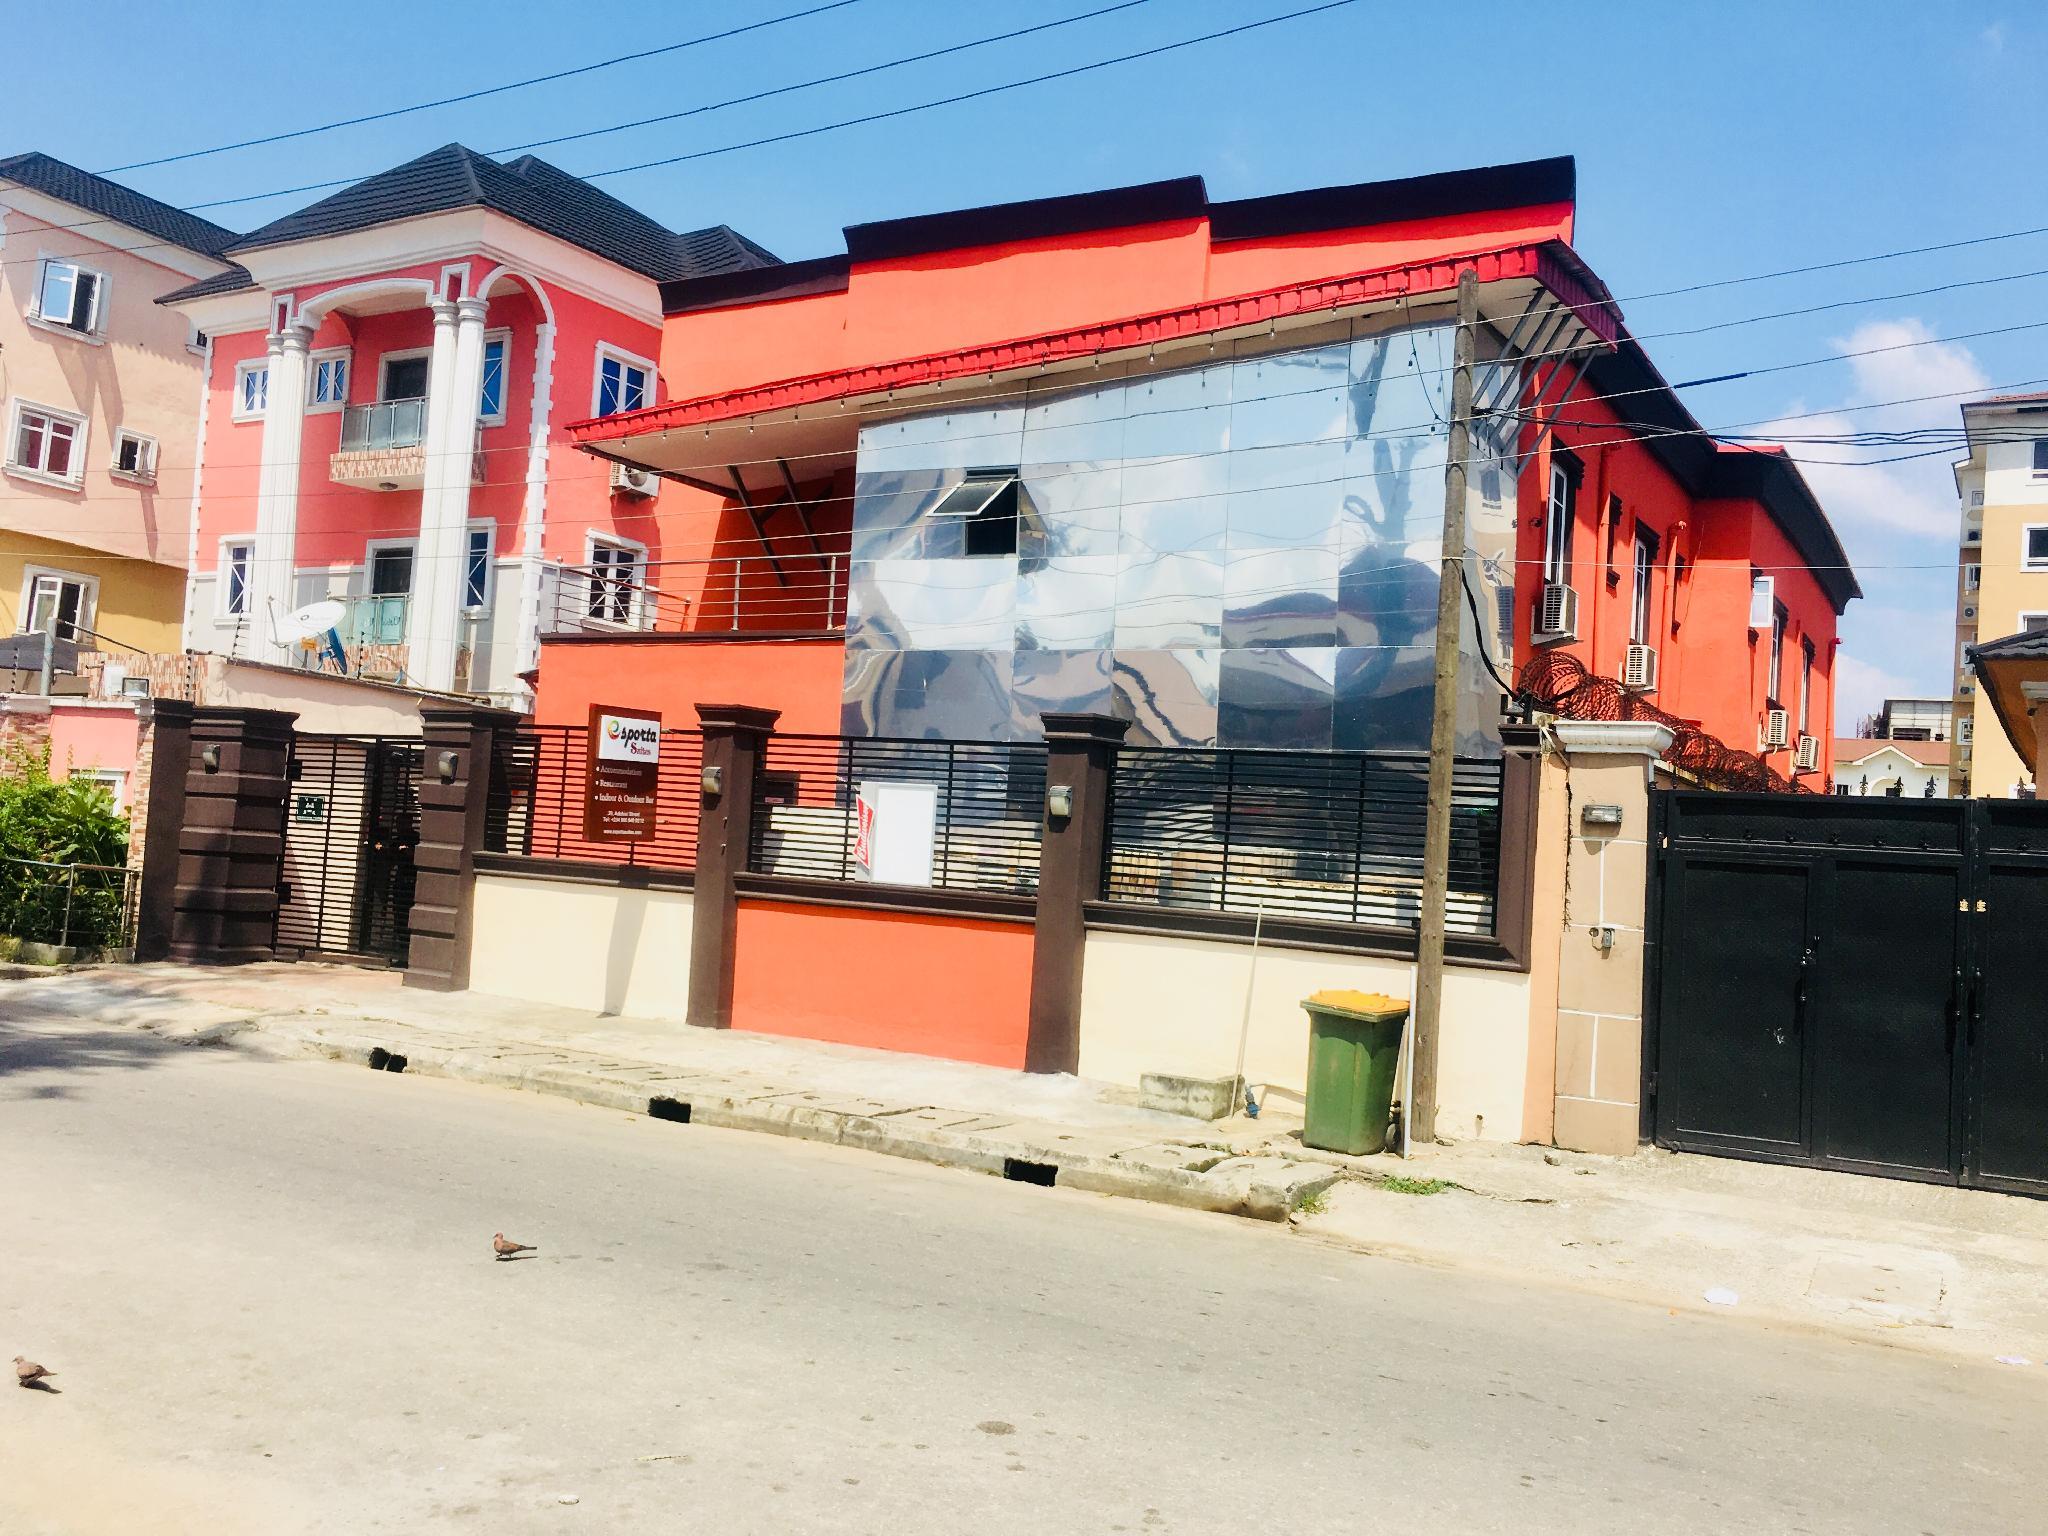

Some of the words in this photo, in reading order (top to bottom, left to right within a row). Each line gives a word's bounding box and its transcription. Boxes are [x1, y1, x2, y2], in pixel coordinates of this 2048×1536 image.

[630, 742, 651, 755] Suites
[599, 779, 628, 789] Restaurant
[599, 793, 617, 801] Indoor
[617, 794, 624, 802] &
[623, 795, 645, 803] Outdoor
[645, 796, 655, 804] Bar
